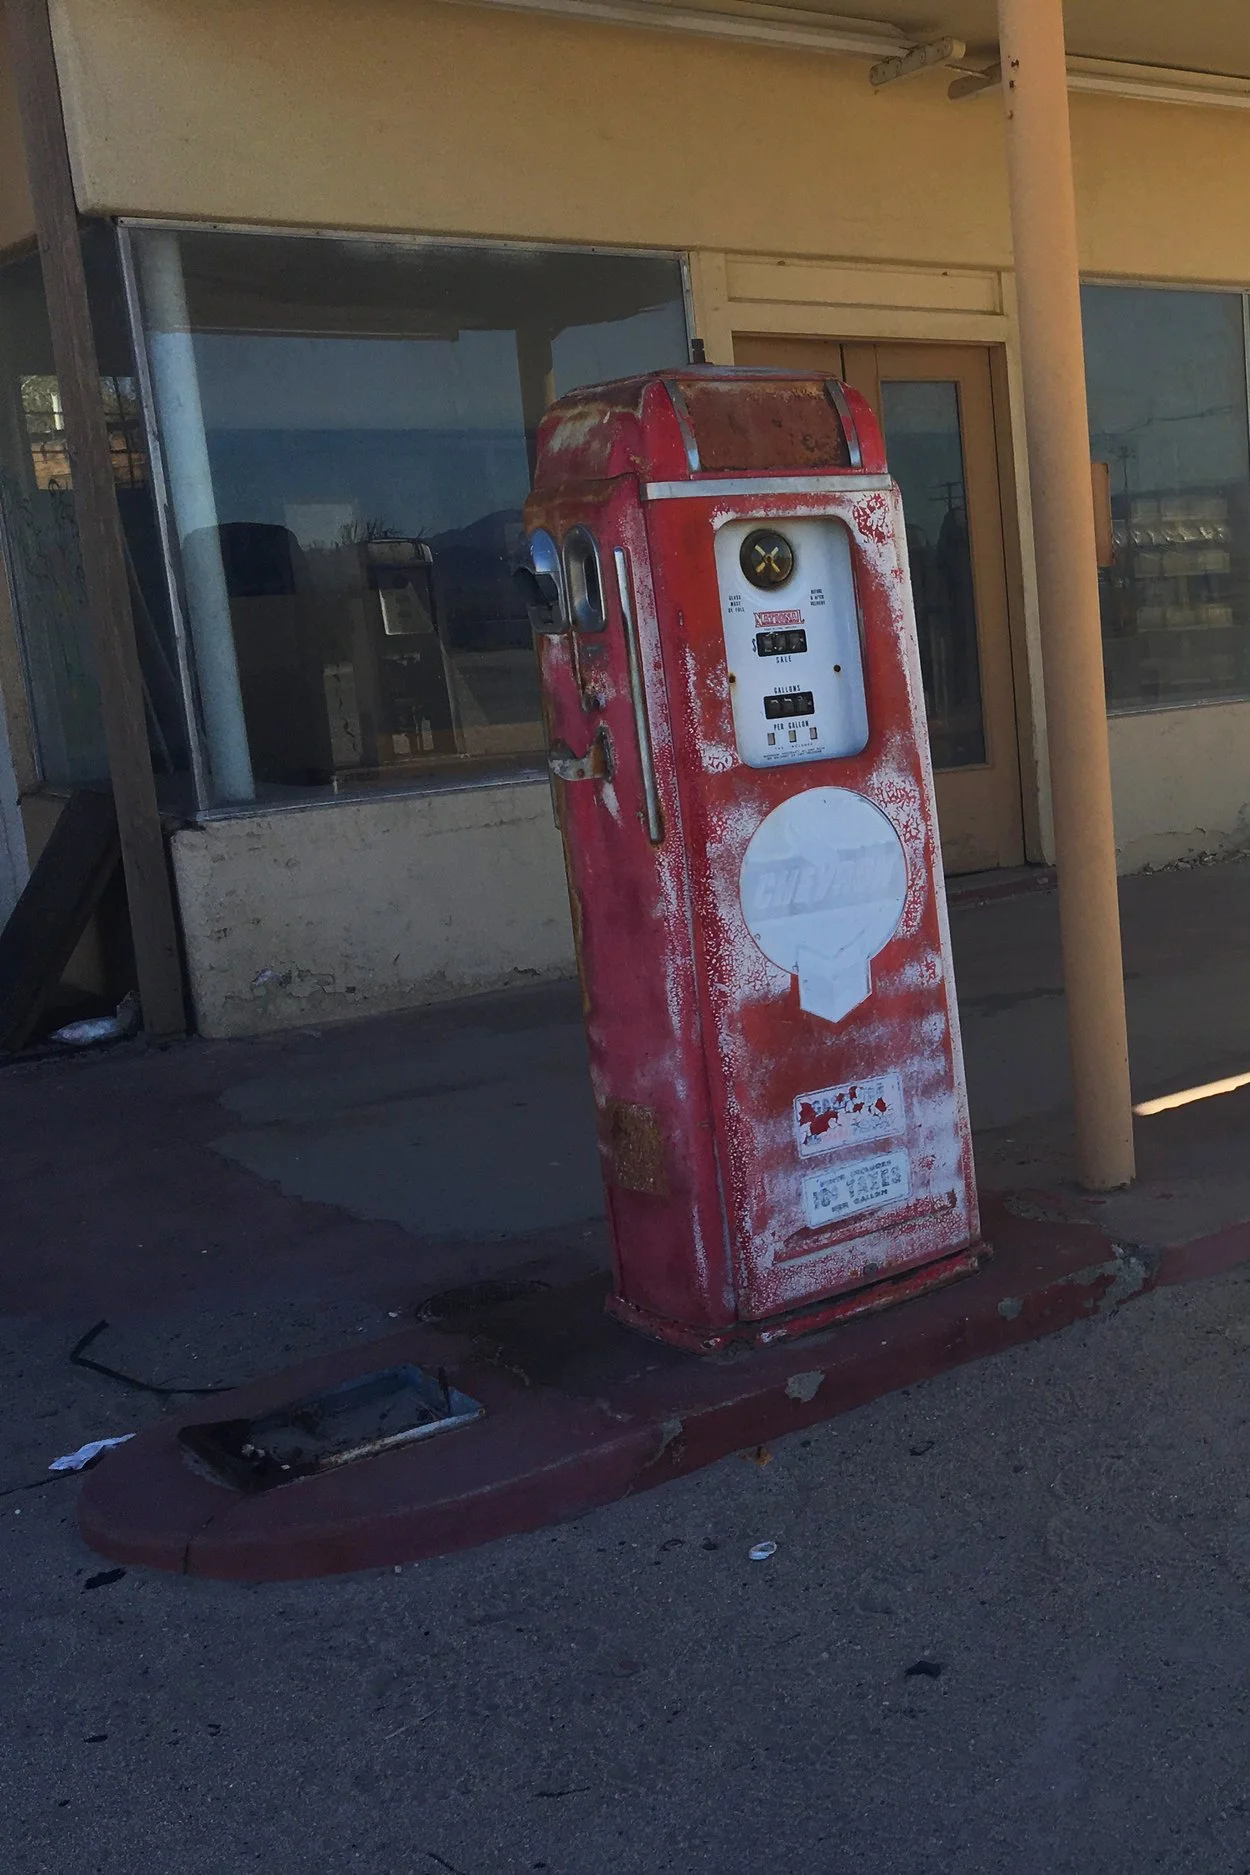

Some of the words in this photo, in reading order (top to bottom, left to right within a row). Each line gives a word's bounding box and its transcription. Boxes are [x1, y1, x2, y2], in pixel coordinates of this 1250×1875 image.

[775, 655, 792, 664] SALE
[773, 684, 801, 694] GALLONS
[773, 723, 784, 731] PER
[788, 720, 809, 730] GALLON
[853, 1189, 888, 1205] GALLON
